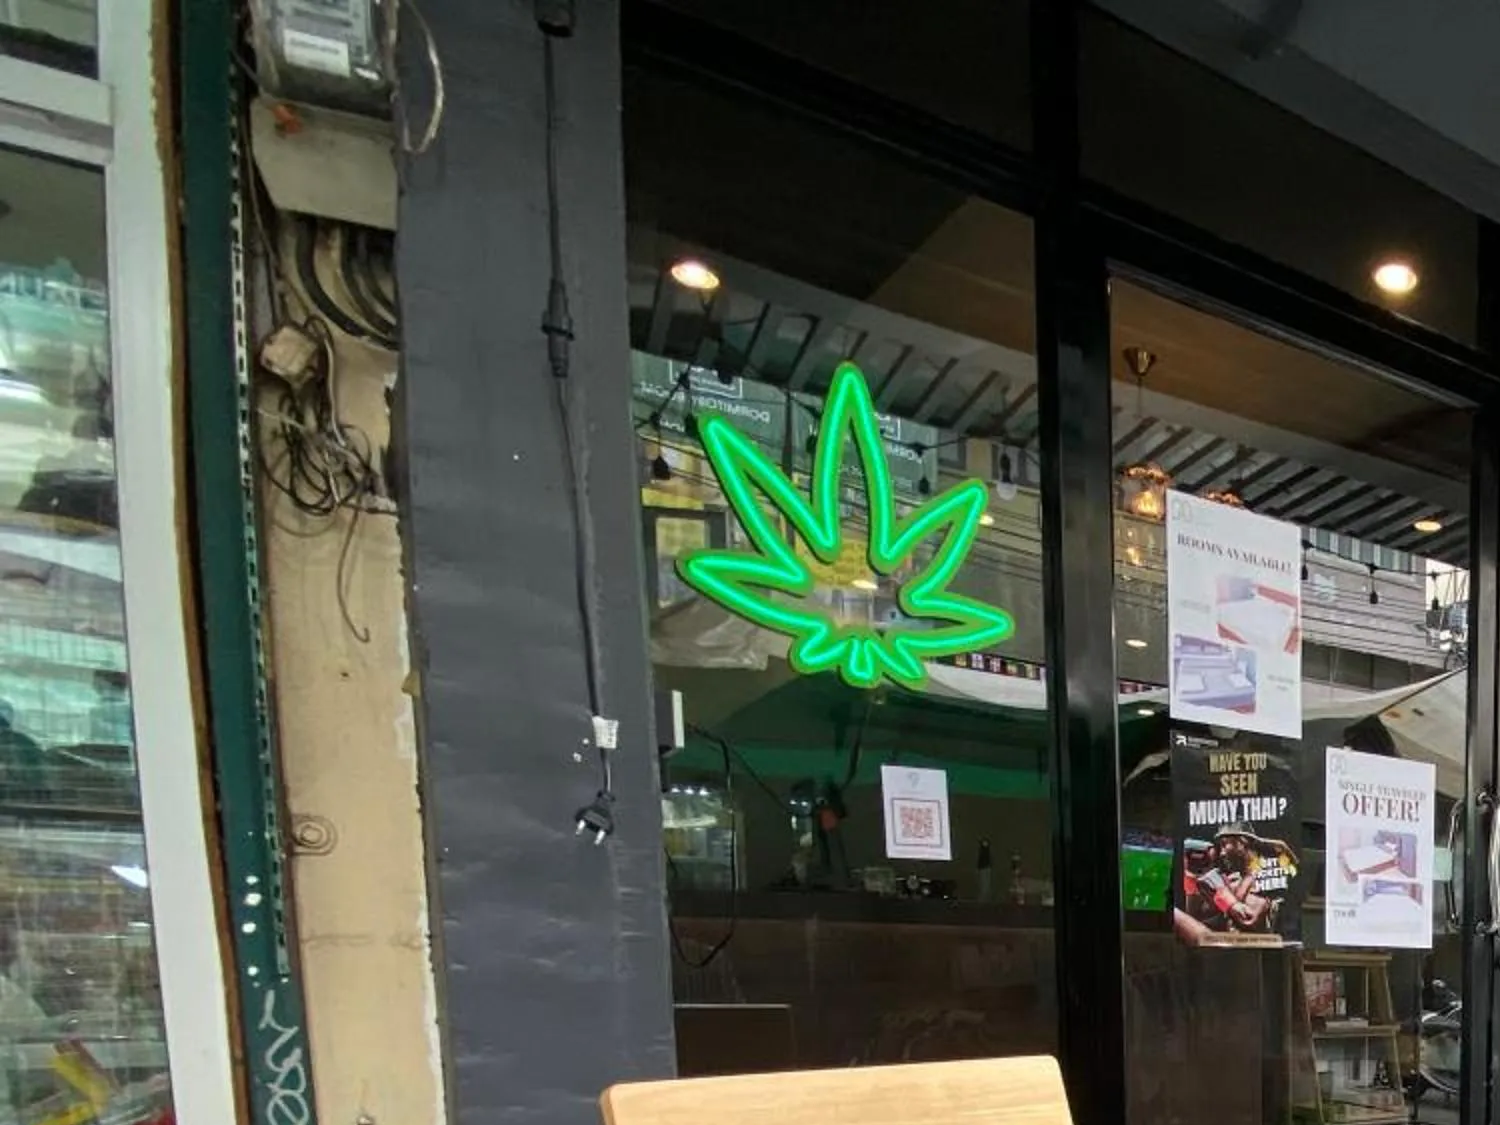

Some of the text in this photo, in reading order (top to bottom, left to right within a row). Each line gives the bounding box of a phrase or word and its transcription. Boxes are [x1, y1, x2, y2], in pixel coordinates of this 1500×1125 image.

[1209, 751, 1267, 773] HAVE YOU
[1220, 773, 1258, 796] SEEN
[1188, 799, 1239, 826] MUAY
[1342, 792, 1420, 822] OFFER!
